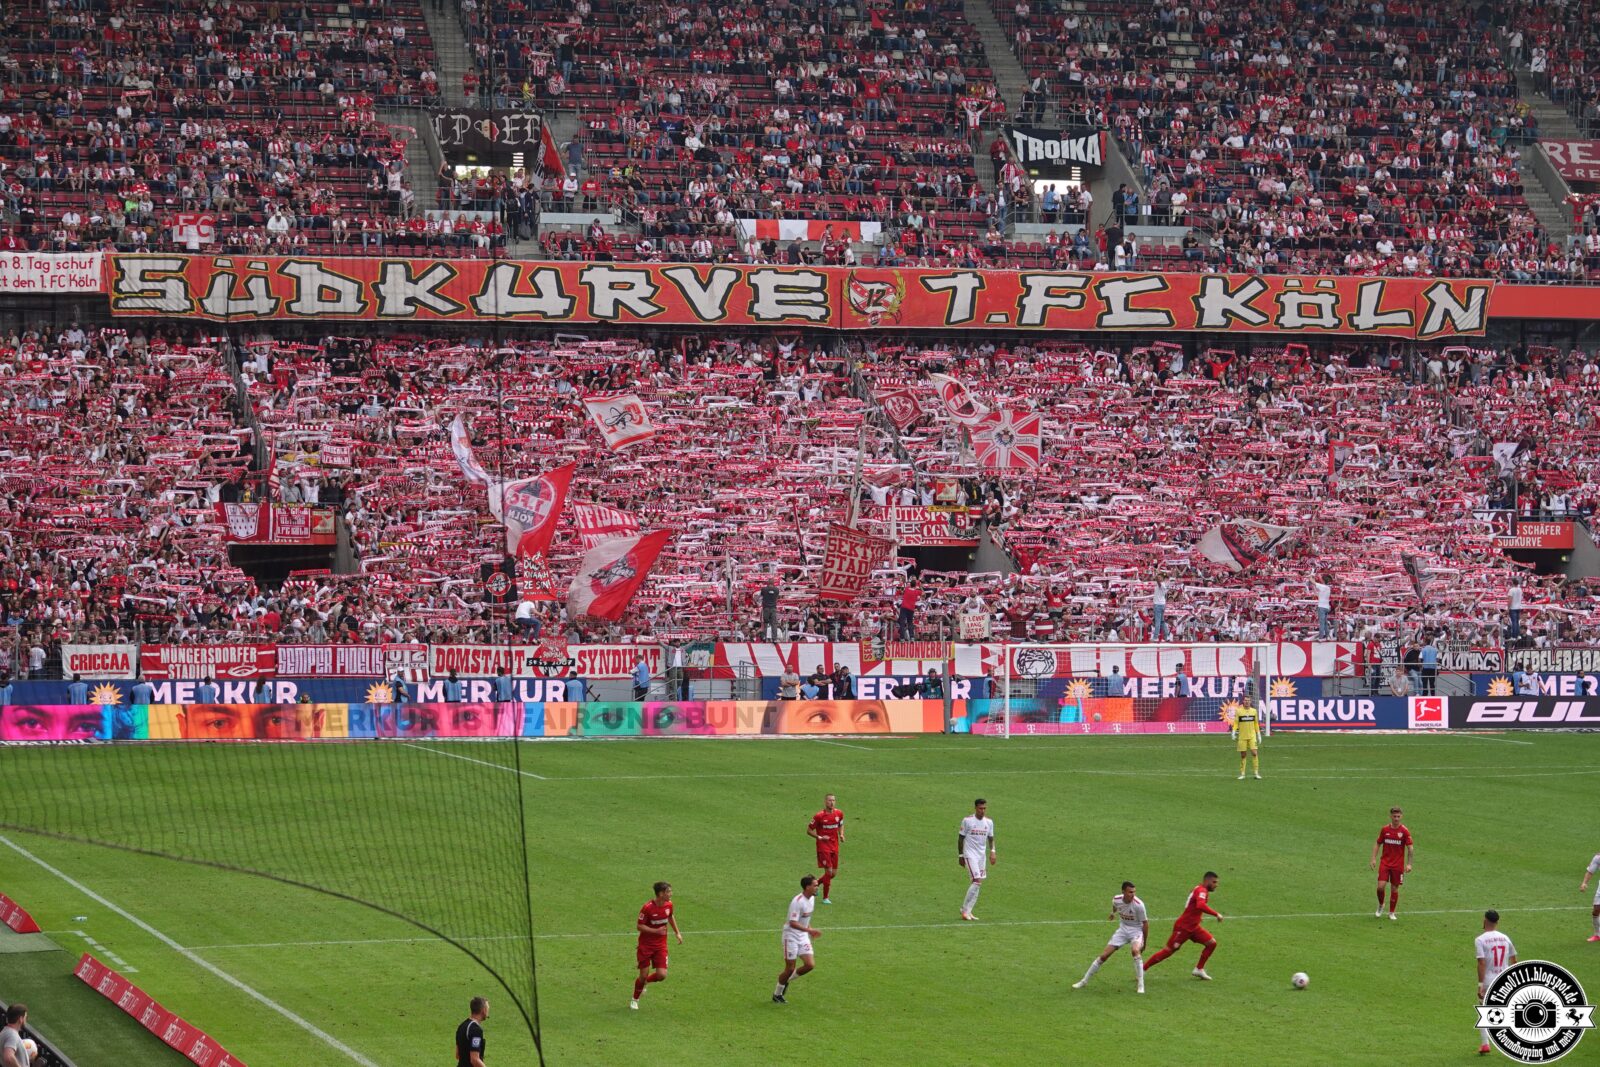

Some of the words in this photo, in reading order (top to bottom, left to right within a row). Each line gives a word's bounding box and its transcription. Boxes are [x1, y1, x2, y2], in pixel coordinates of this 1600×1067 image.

[1013, 130, 1102, 166] TROIKA
[1542, 141, 1600, 165] RE
[178, 215, 214, 238] FC
[12, 256, 23, 269] 8.
[27, 256, 50, 273] Tag
[56, 257, 94, 270] schuf
[13, 274, 35, 288] den
[50, 275, 66, 288] FC
[69, 274, 97, 288] Köln
[1523, 523, 1561, 536] SCHÄFER
[160, 646, 257, 664] MÜNGERSDORFER
[885, 640, 952, 659] STADIONVERBT
[70, 653, 130, 671] CRICCAA
[277, 646, 333, 675] SEMPER
[337, 646, 384, 675] FIDELIS
[435, 647, 525, 675] DOMSTADT
[1437, 651, 1500, 671] OLONIACS
[168, 663, 216, 680] STADION
[417, 680, 565, 703] MRUR
[294, 708, 441, 733] MERKUR
[684, 706, 778, 729] BUNT
[1258, 700, 1376, 720] MERKUR
[1491, 945, 1506, 967] 17
